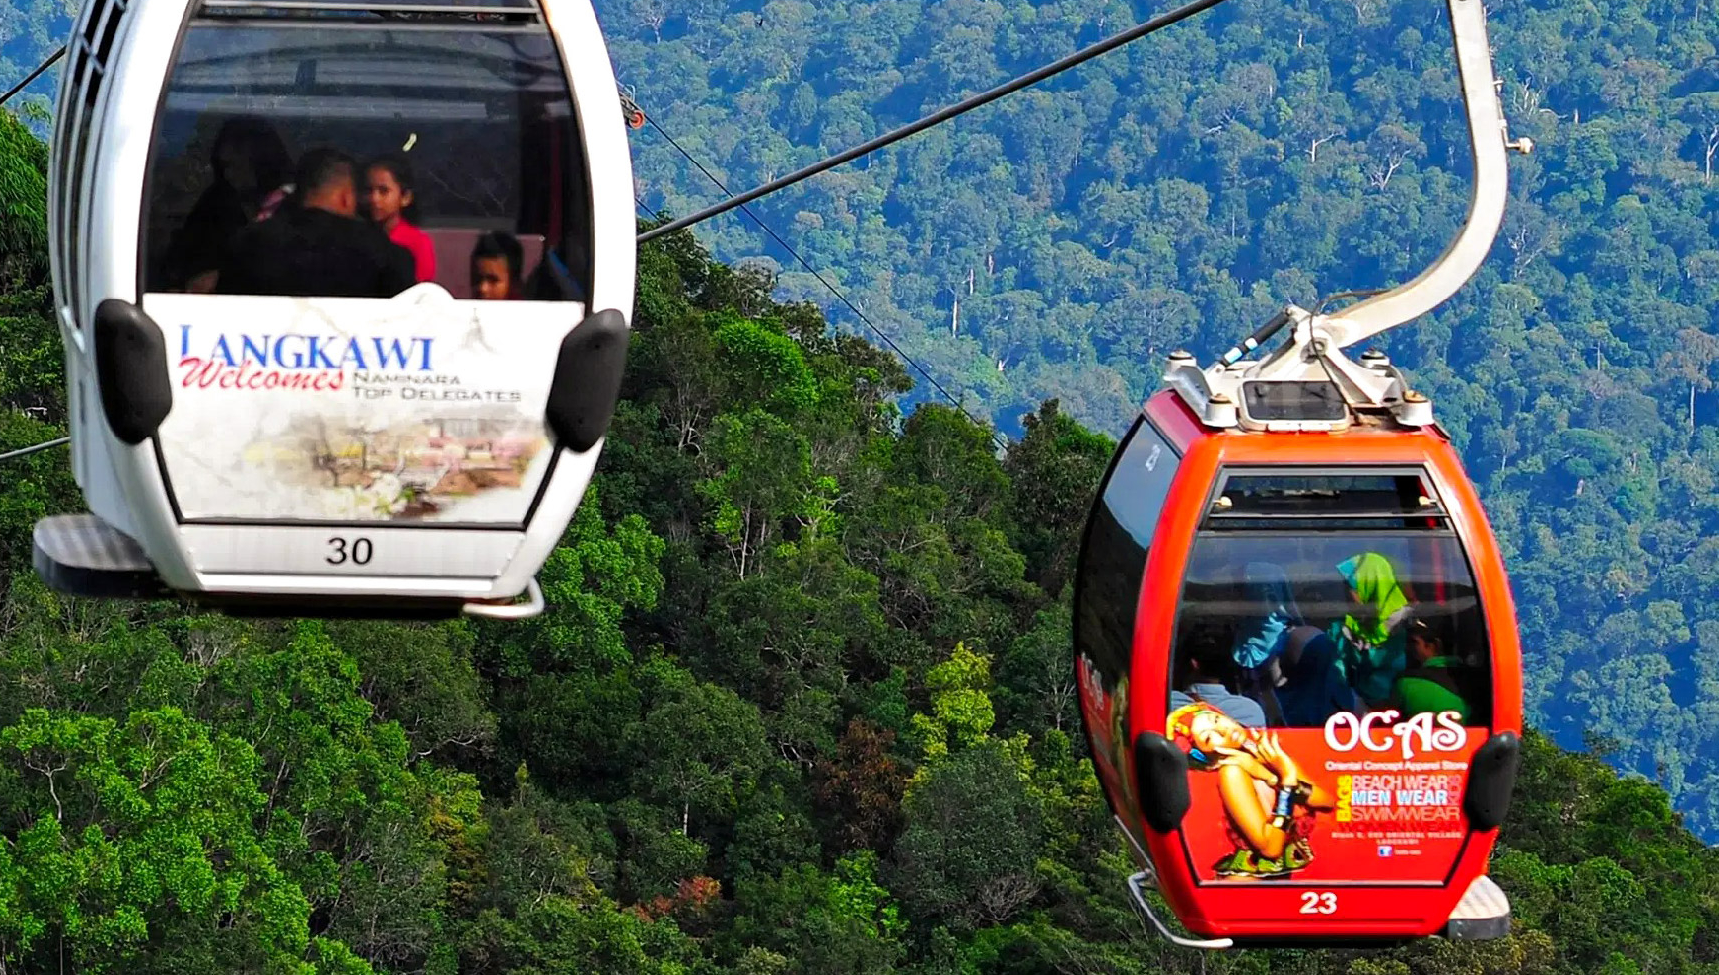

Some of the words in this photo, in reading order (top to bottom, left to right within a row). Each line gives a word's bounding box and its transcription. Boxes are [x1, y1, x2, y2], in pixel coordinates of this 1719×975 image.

[180, 324, 434, 371] LANGKAWI
[179, 356, 344, 391] Welcomes
[354, 386, 392, 400] TOP
[401, 387, 522, 403] DELEGATES
[326, 537, 373, 566] 30
[1324, 710, 1468, 760] OCAS
[1352, 776, 1402, 790] BEACH
[1403, 776, 1448, 790] WEAR
[1336, 775, 1352, 822] BAGS
[1352, 790, 1392, 805] MEN
[1396, 790, 1448, 805] WEAR
[1351, 807, 1461, 821] SWIMWEAR
[1300, 892, 1338, 915] 23
